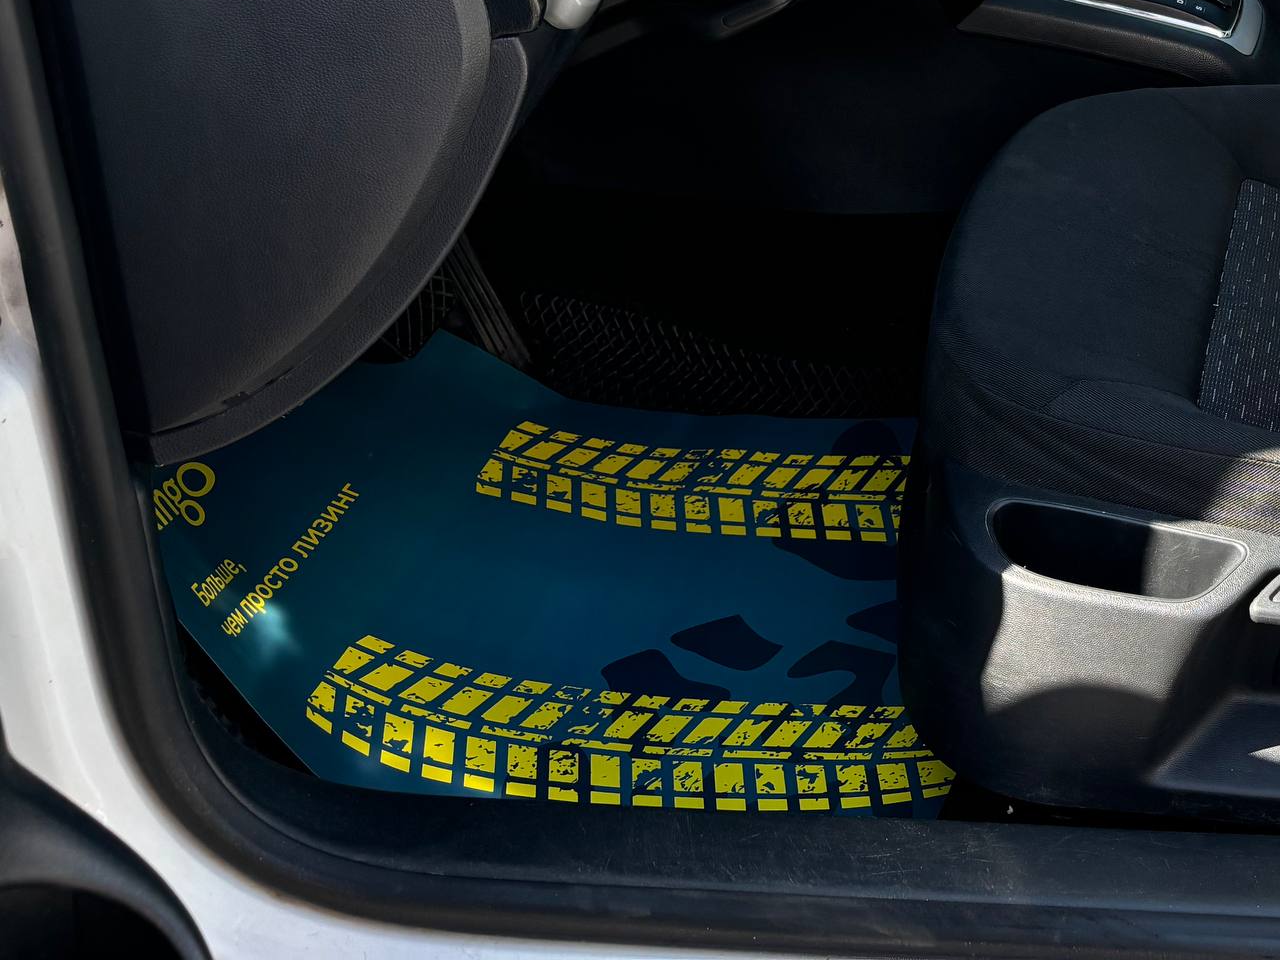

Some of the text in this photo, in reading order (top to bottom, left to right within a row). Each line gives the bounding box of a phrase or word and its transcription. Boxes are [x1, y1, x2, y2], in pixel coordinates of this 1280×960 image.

[191, 558, 247, 607] Больше,
[221, 483, 360, 637] чем просто лизинг
